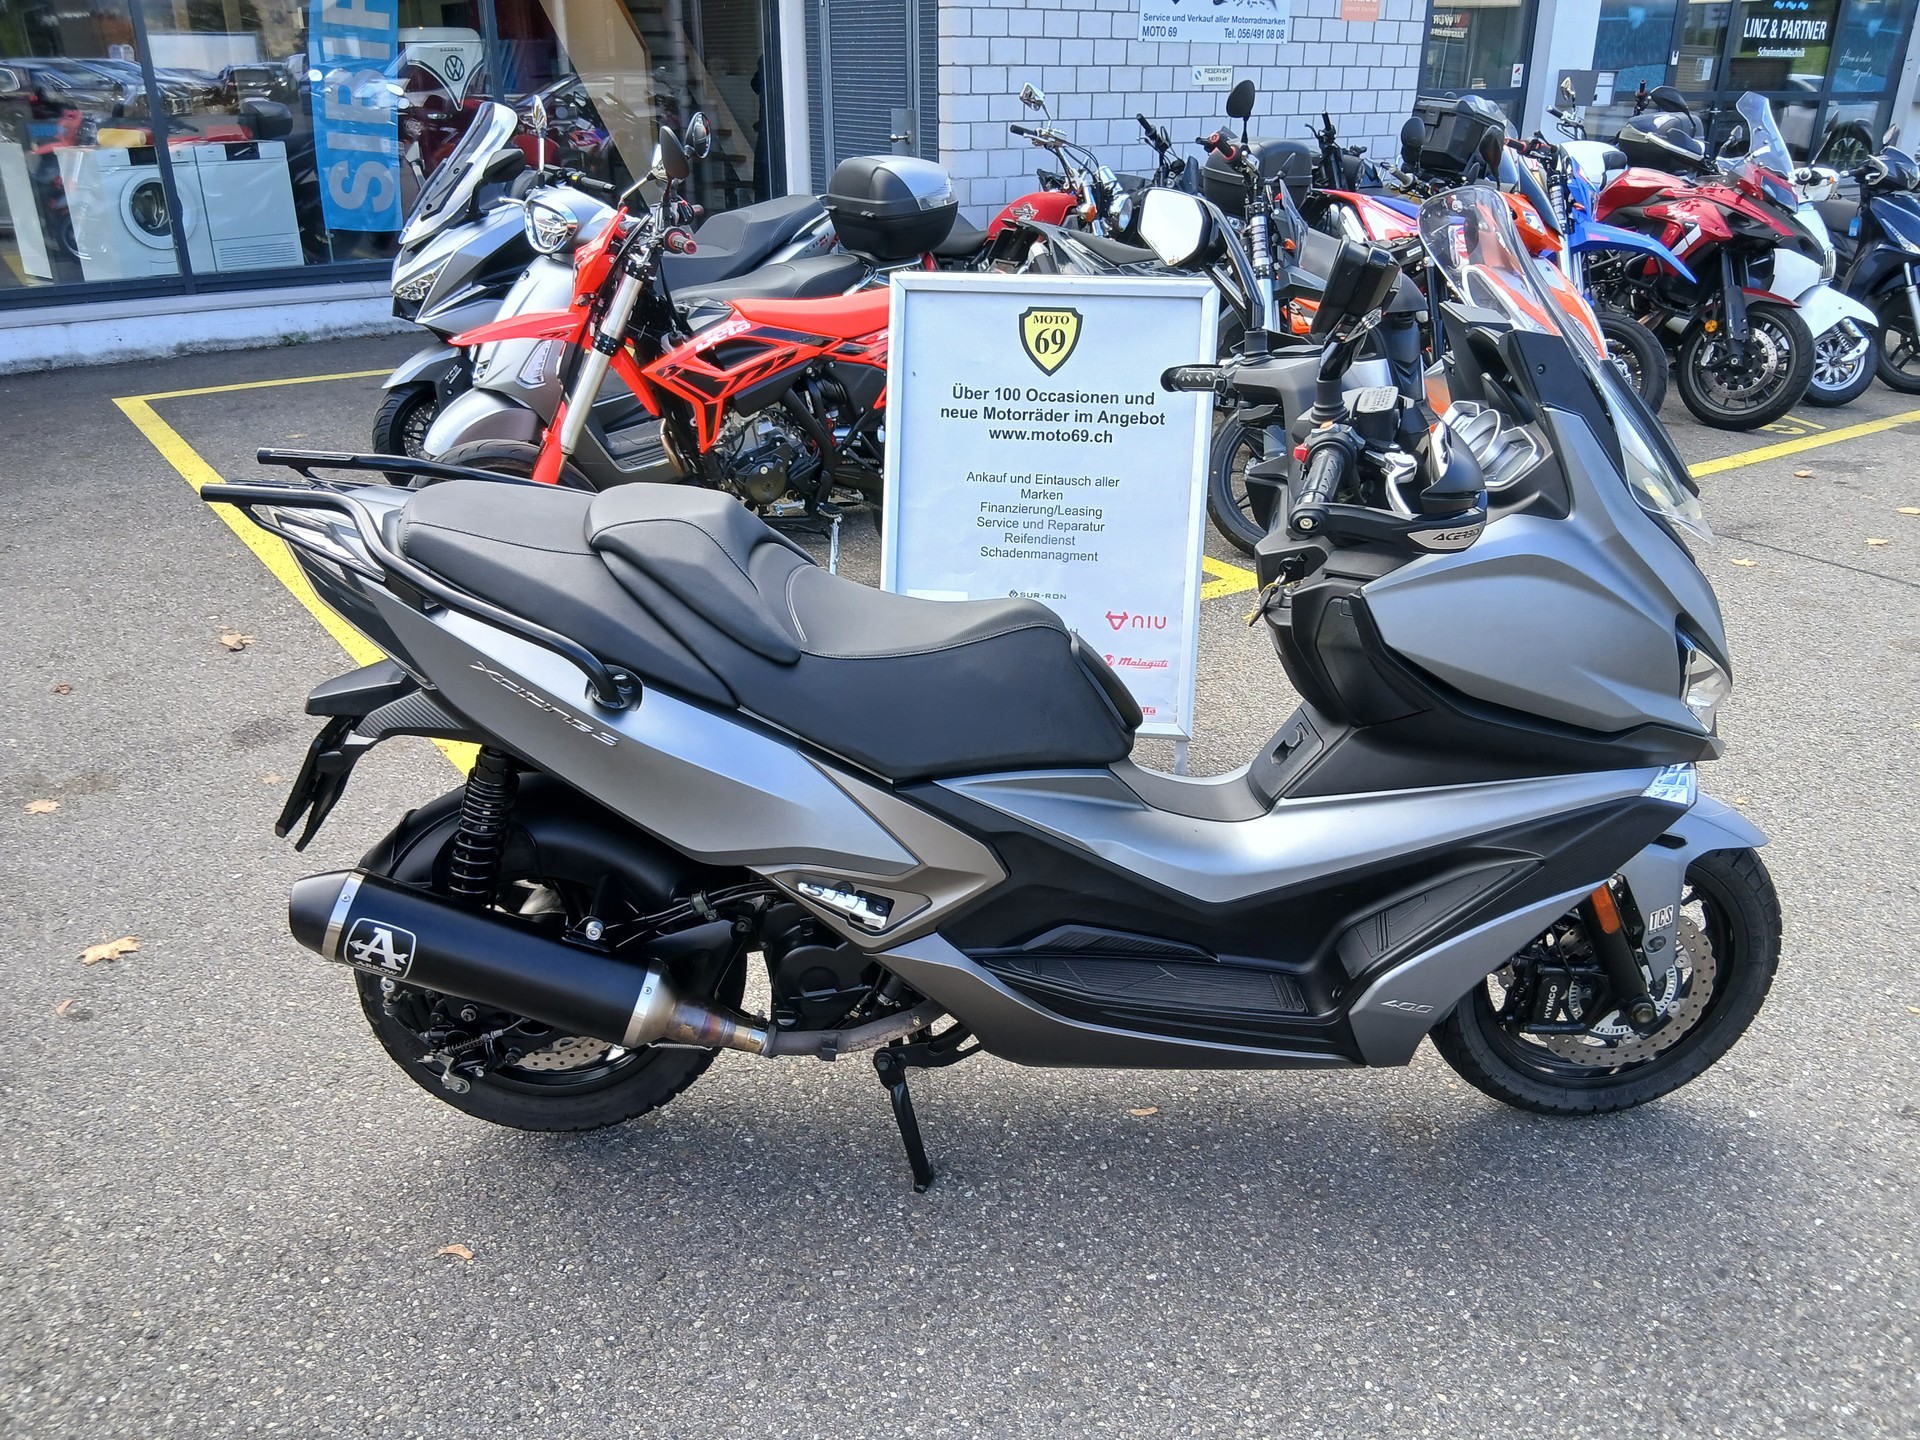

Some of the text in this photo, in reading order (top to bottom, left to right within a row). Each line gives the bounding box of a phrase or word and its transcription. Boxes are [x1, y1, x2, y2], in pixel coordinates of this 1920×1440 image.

[1144, 13, 1170, 22] Service
[1172, 14, 1186, 22] und
[1188, 14, 1214, 22] Verkauf
[1232, 16, 1286, 25] Motorradmarken
[1142, 26, 1177, 37] MOTO 69
[1224, 28, 1284, 39] Tel. 056/491 08 08
[1744, 18, 1827, 40] LINZ & PARTNER
[1033, 314, 1070, 325] MOTO
[1035, 328, 1065, 355] 69
[952, 382, 1155, 406] Über 100 Occasionen und
[941, 407, 1166, 426] neue Motorräder im Angebot
[989, 428, 1113, 443] www.moto69.ch
[966, 471, 1120, 488] Ankauf und Eintausch aller
[1020, 488, 1064, 500] Marken
[980, 502, 1103, 518] Finanzierung/Leasing
[977, 517, 1105, 534] Service und Reparatur
[1004, 532, 1076, 546] Reifendienst
[980, 546, 1099, 564] Schadenmanagment
[1020, 591, 1067, 600] SUR-RON
[1118, 657, 1168, 669] Malaguti
[1652, 906, 1672, 928] TCS
[356, 961, 398, 975] ARROW
[1544, 985, 1558, 1019] KYMCO
